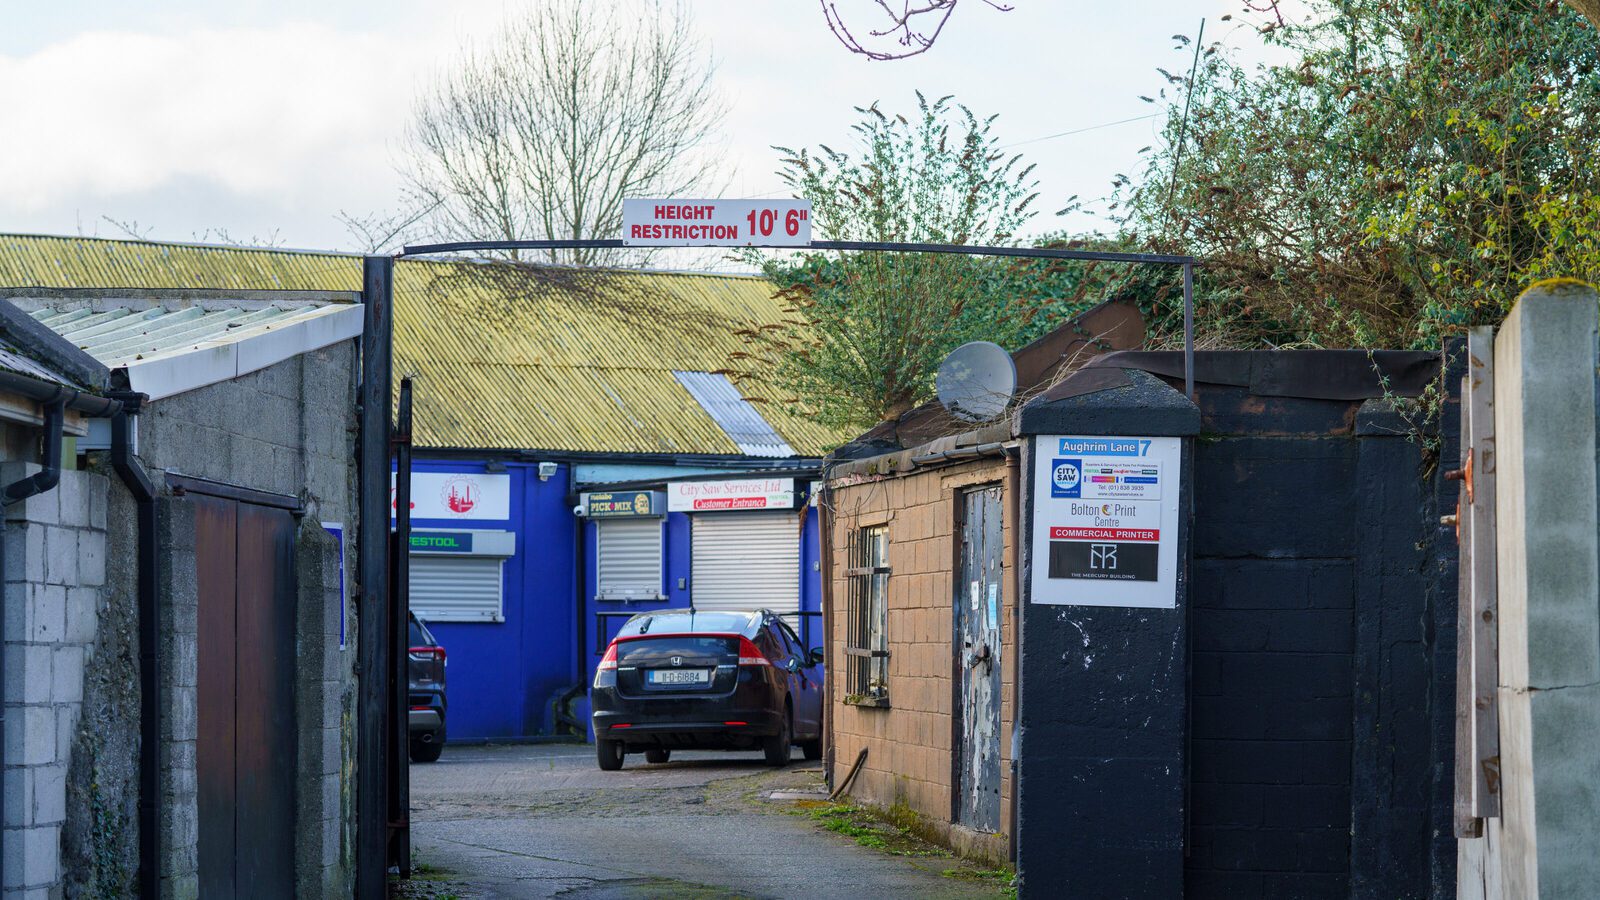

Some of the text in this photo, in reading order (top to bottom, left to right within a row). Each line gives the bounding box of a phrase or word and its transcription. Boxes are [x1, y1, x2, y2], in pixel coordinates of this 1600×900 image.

[654, 205, 715, 220] HEIGHT
[747, 209, 808, 237] 10' 6"
[631, 224, 738, 240] RESTRICTION
[1063, 439, 1152, 457] Aughrim Lane 7
[1057, 467, 1076, 475] CITY
[680, 479, 781, 497] City Saw Services Ltd
[591, 502, 611, 511] PICK
[614, 501, 632, 511] MIX
[695, 499, 731, 509] Customer
[731, 497, 765, 508] Entrance
[1071, 503, 1136, 517] Bolton Print
[1094, 517, 1120, 527] Centre
[1055, 529, 1154, 539] COMMERCIAL PRINTER
